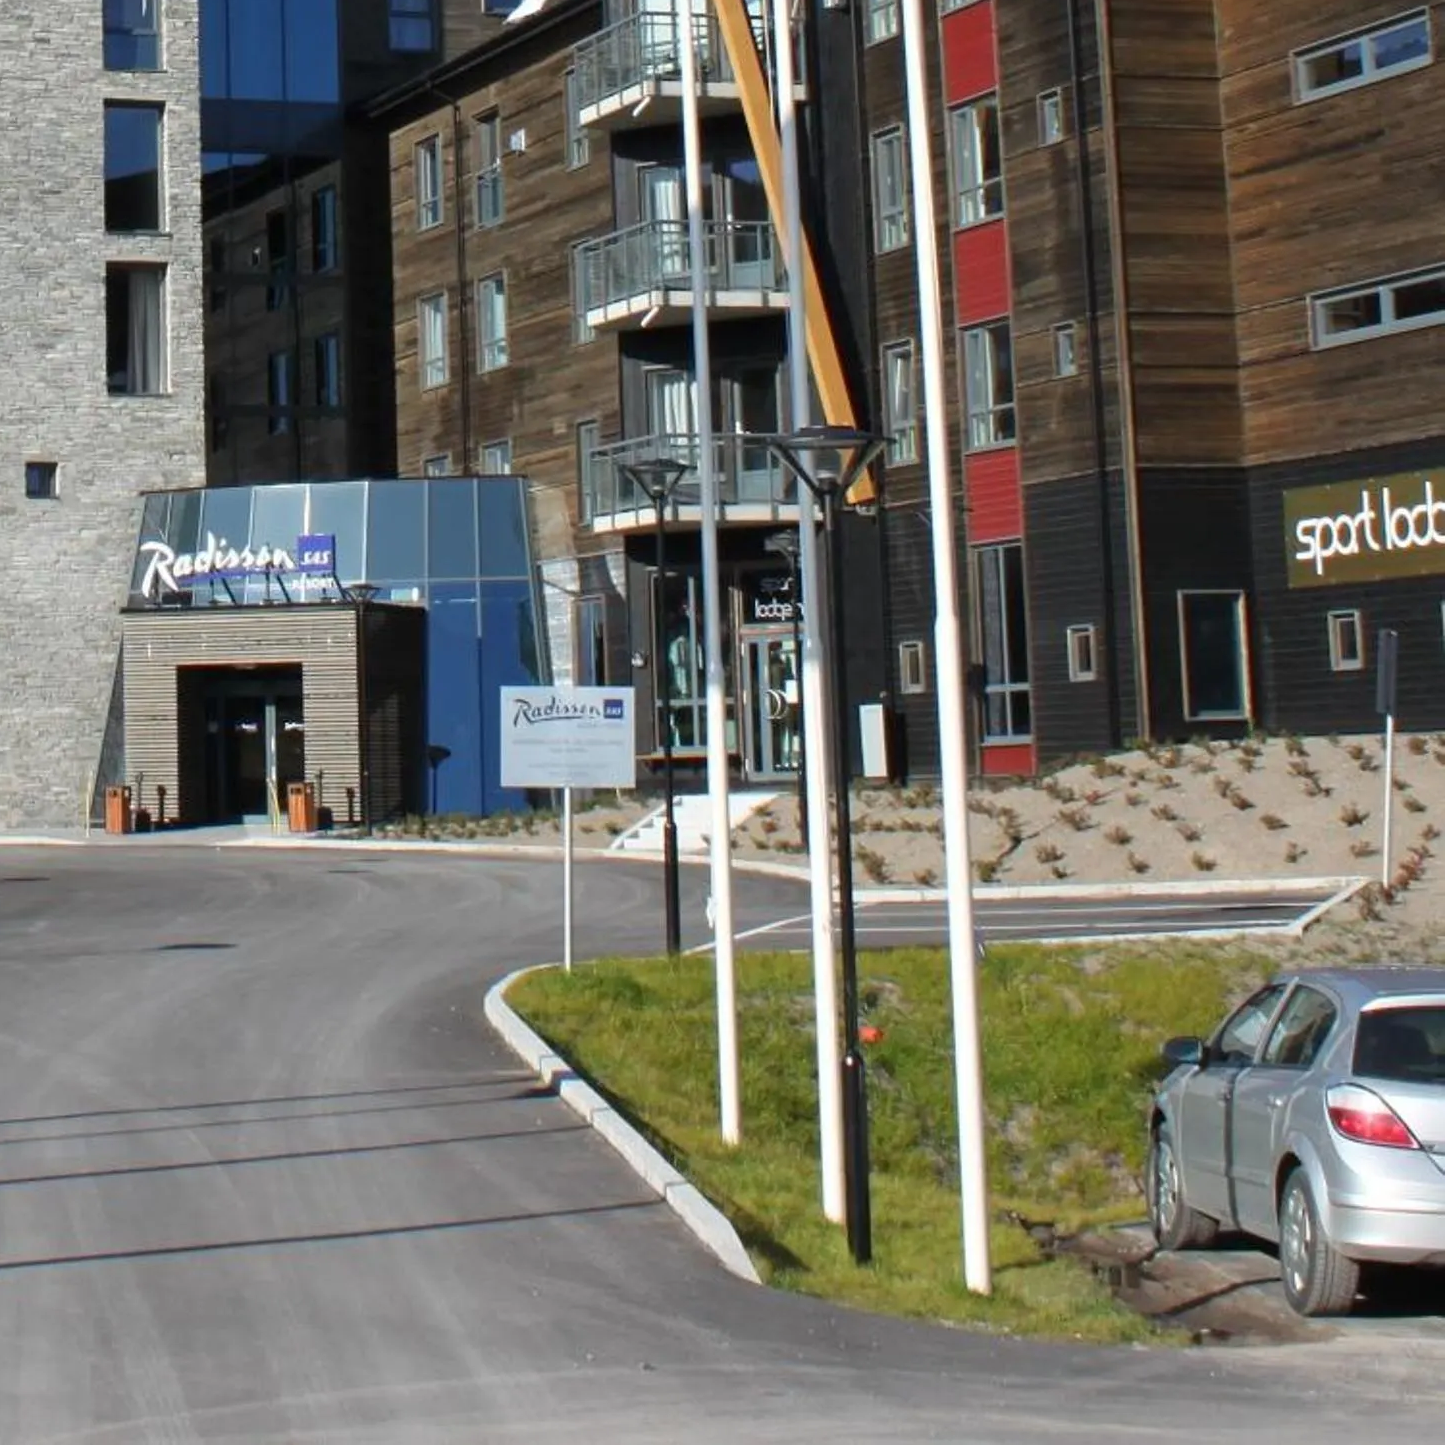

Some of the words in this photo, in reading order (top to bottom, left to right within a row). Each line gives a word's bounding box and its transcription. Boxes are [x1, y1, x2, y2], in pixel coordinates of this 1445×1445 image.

[140, 531, 295, 598] Radisson
[301, 549, 331, 566] SAS
[1295, 490, 1381, 575] sport
[513, 696, 601, 727] Radisson
